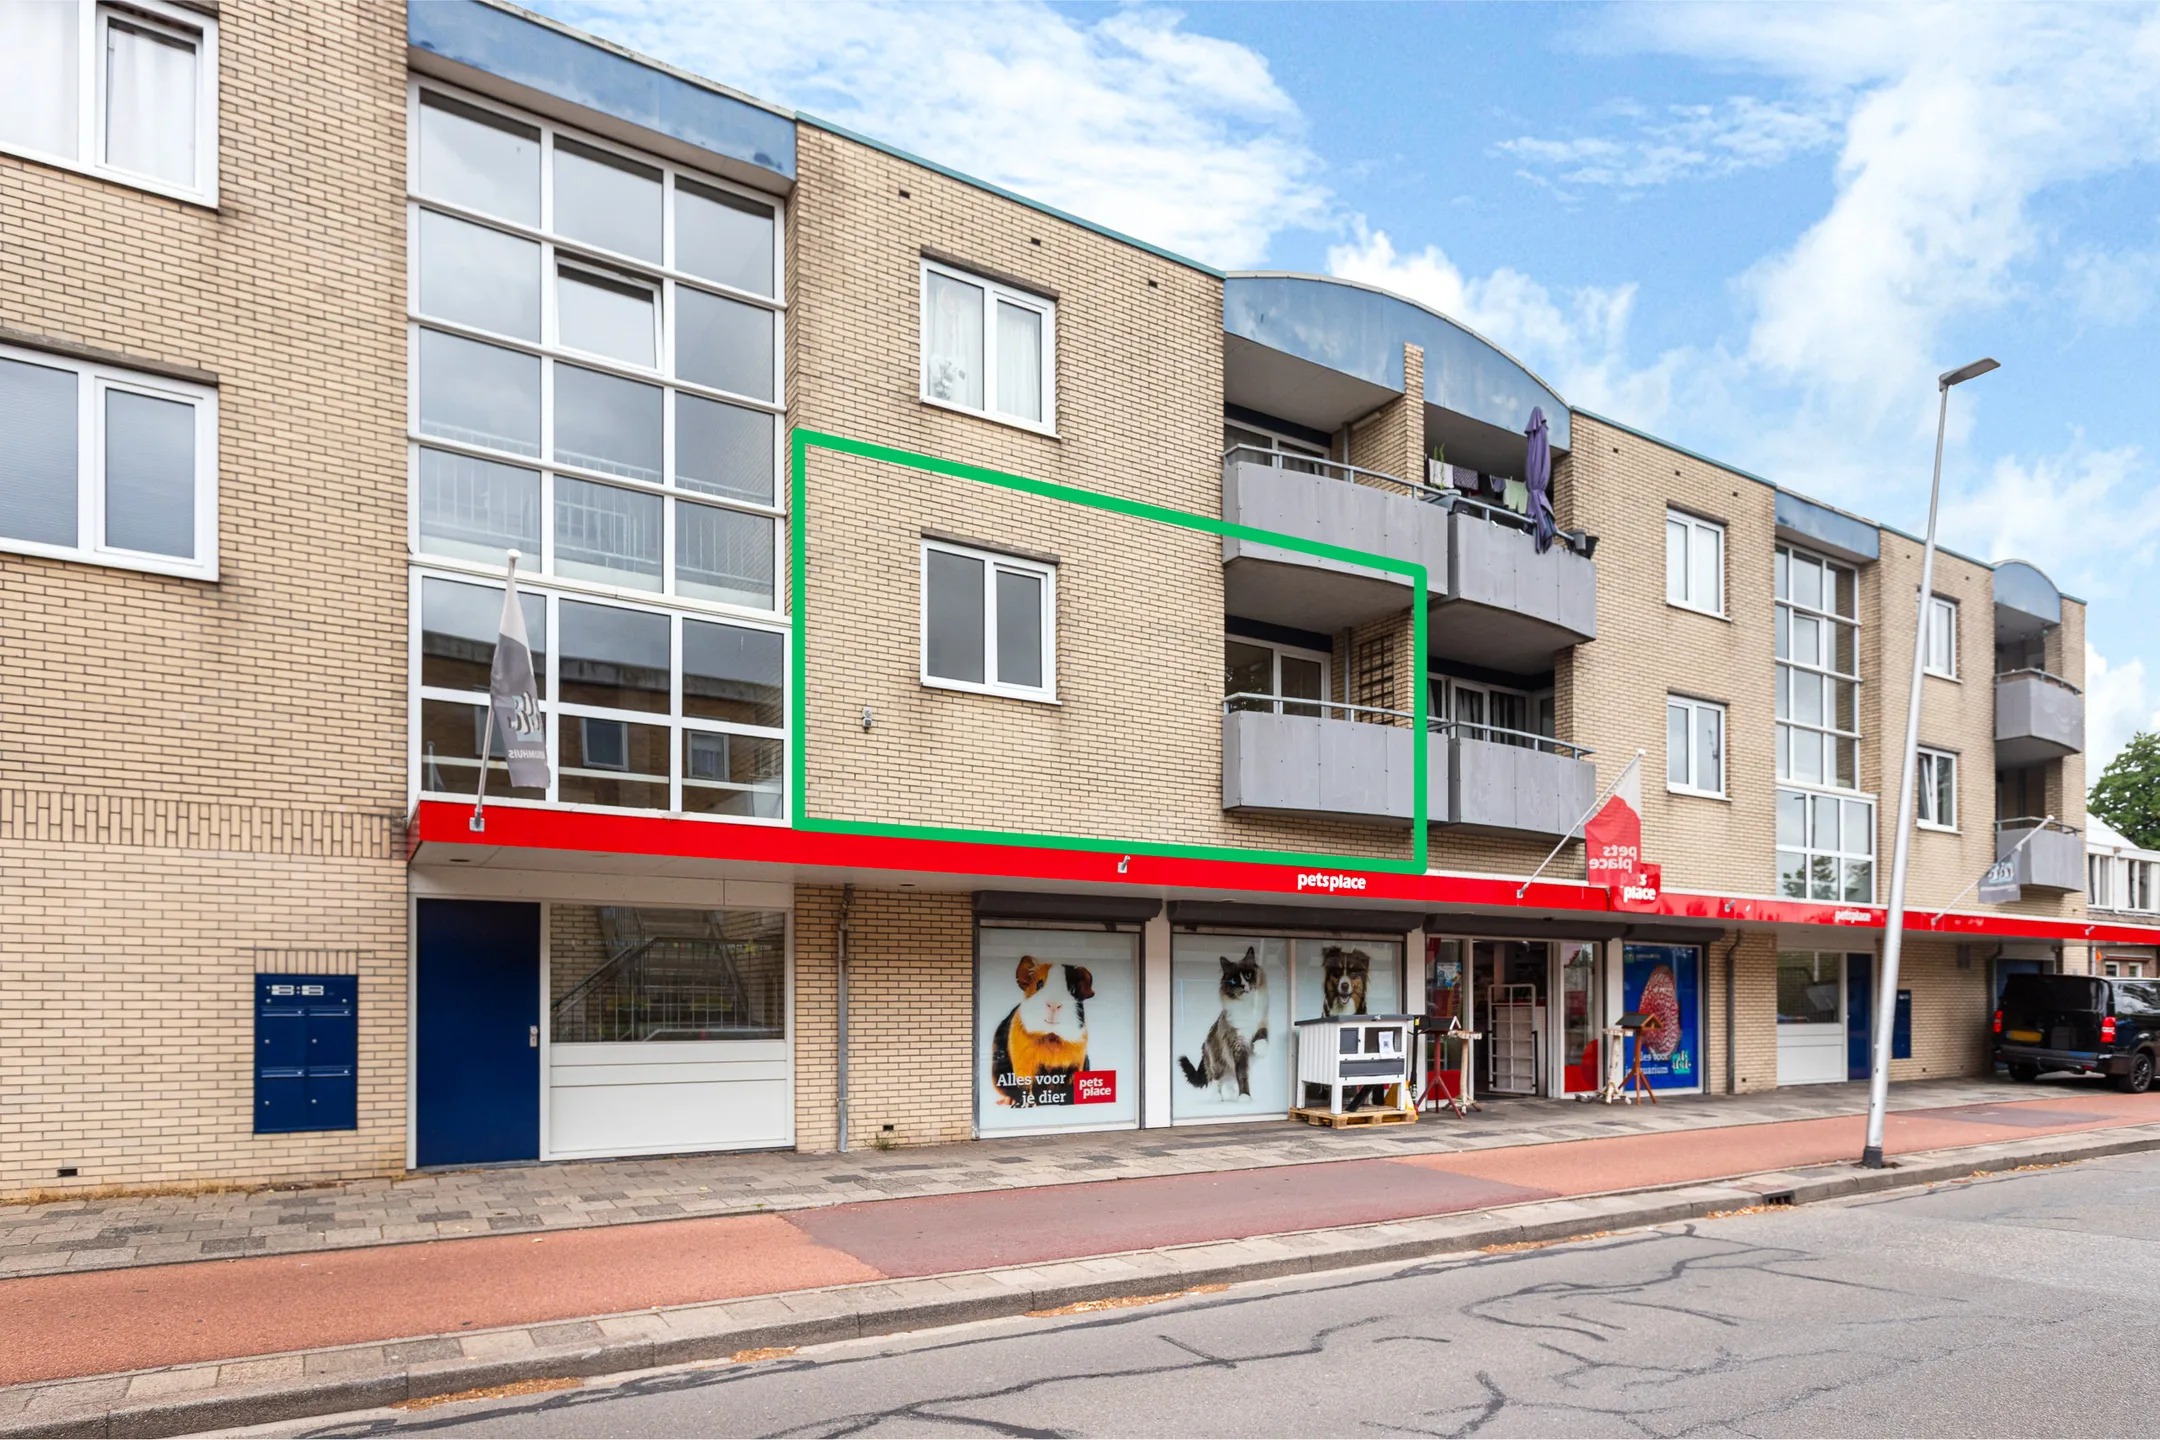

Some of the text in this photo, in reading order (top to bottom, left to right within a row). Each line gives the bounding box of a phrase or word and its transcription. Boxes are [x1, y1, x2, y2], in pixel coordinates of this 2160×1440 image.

[1297, 872, 1367, 892] petsplace
[1623, 885, 1656, 903] place
[996, 1073, 1067, 1087] Alles voor
[1079, 1077, 1103, 1091] pets
[1021, 1090, 1067, 1108] je dier
[1083, 1086, 1111, 1099] place
